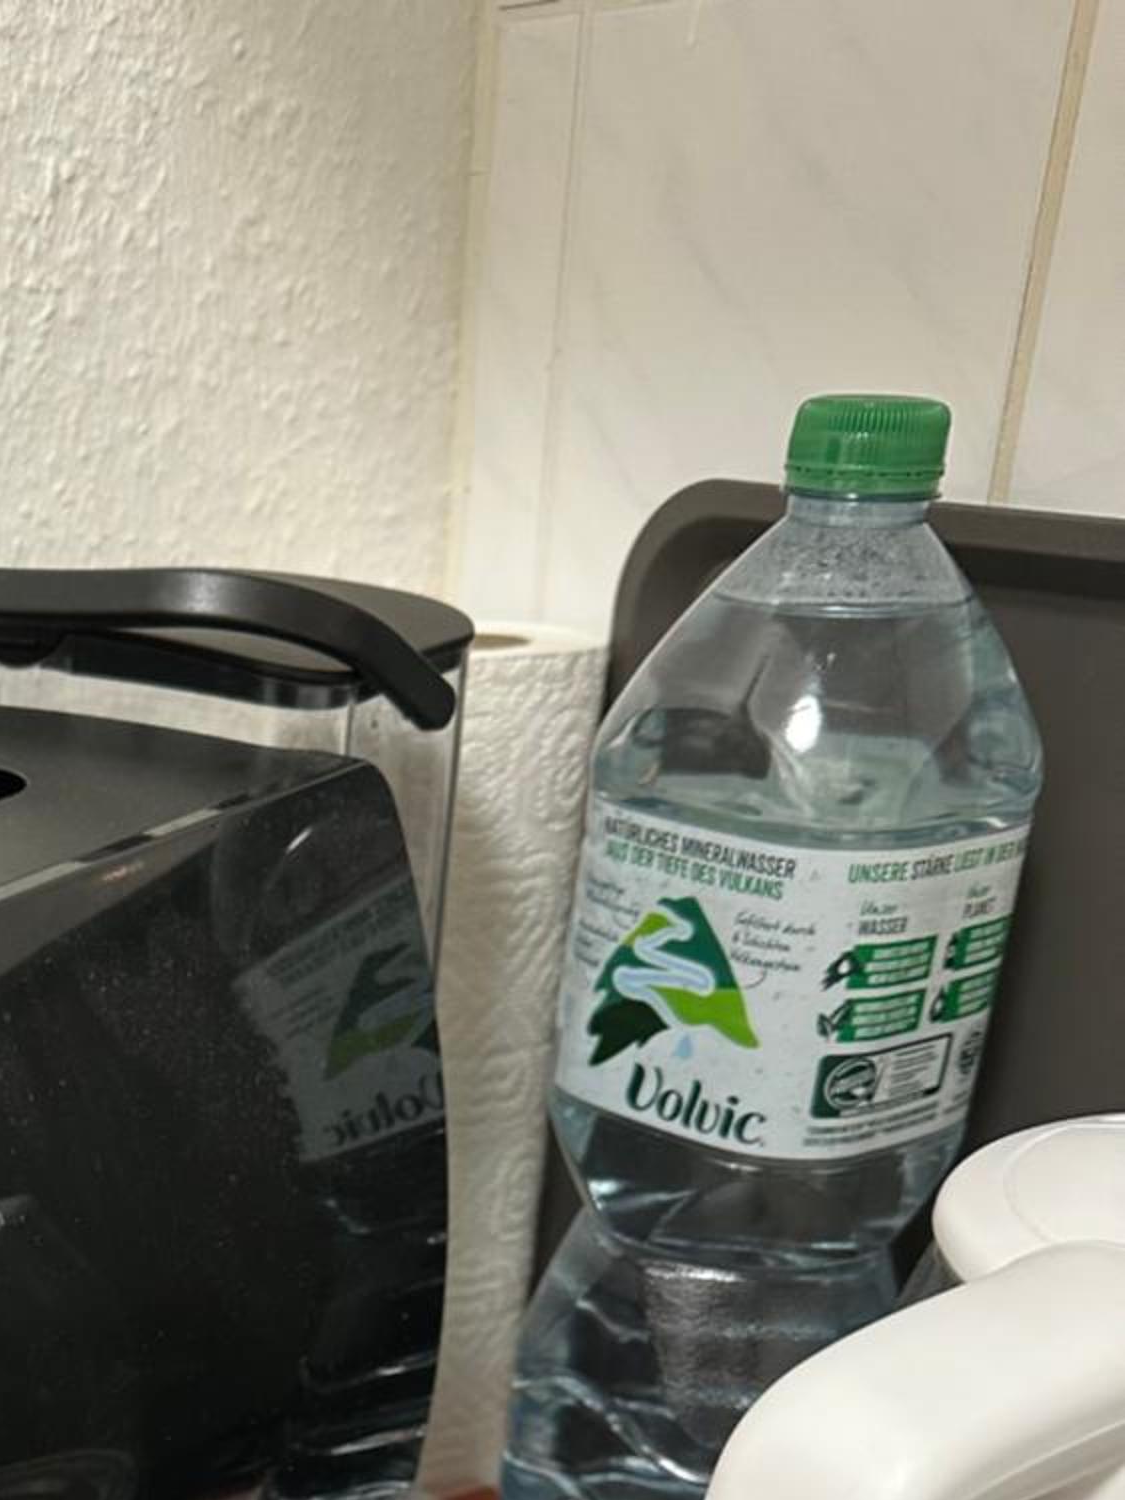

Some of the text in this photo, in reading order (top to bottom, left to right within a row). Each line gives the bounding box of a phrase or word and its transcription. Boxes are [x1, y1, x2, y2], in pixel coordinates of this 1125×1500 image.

[681, 837, 796, 879] MINERALWASSER
[848, 862, 909, 883] UNSERE
[691, 861, 716, 885] DES
[719, 869, 785, 900] VULKANS
[858, 916, 908, 936] WASSER
[627, 1062, 766, 1146] Volvic
